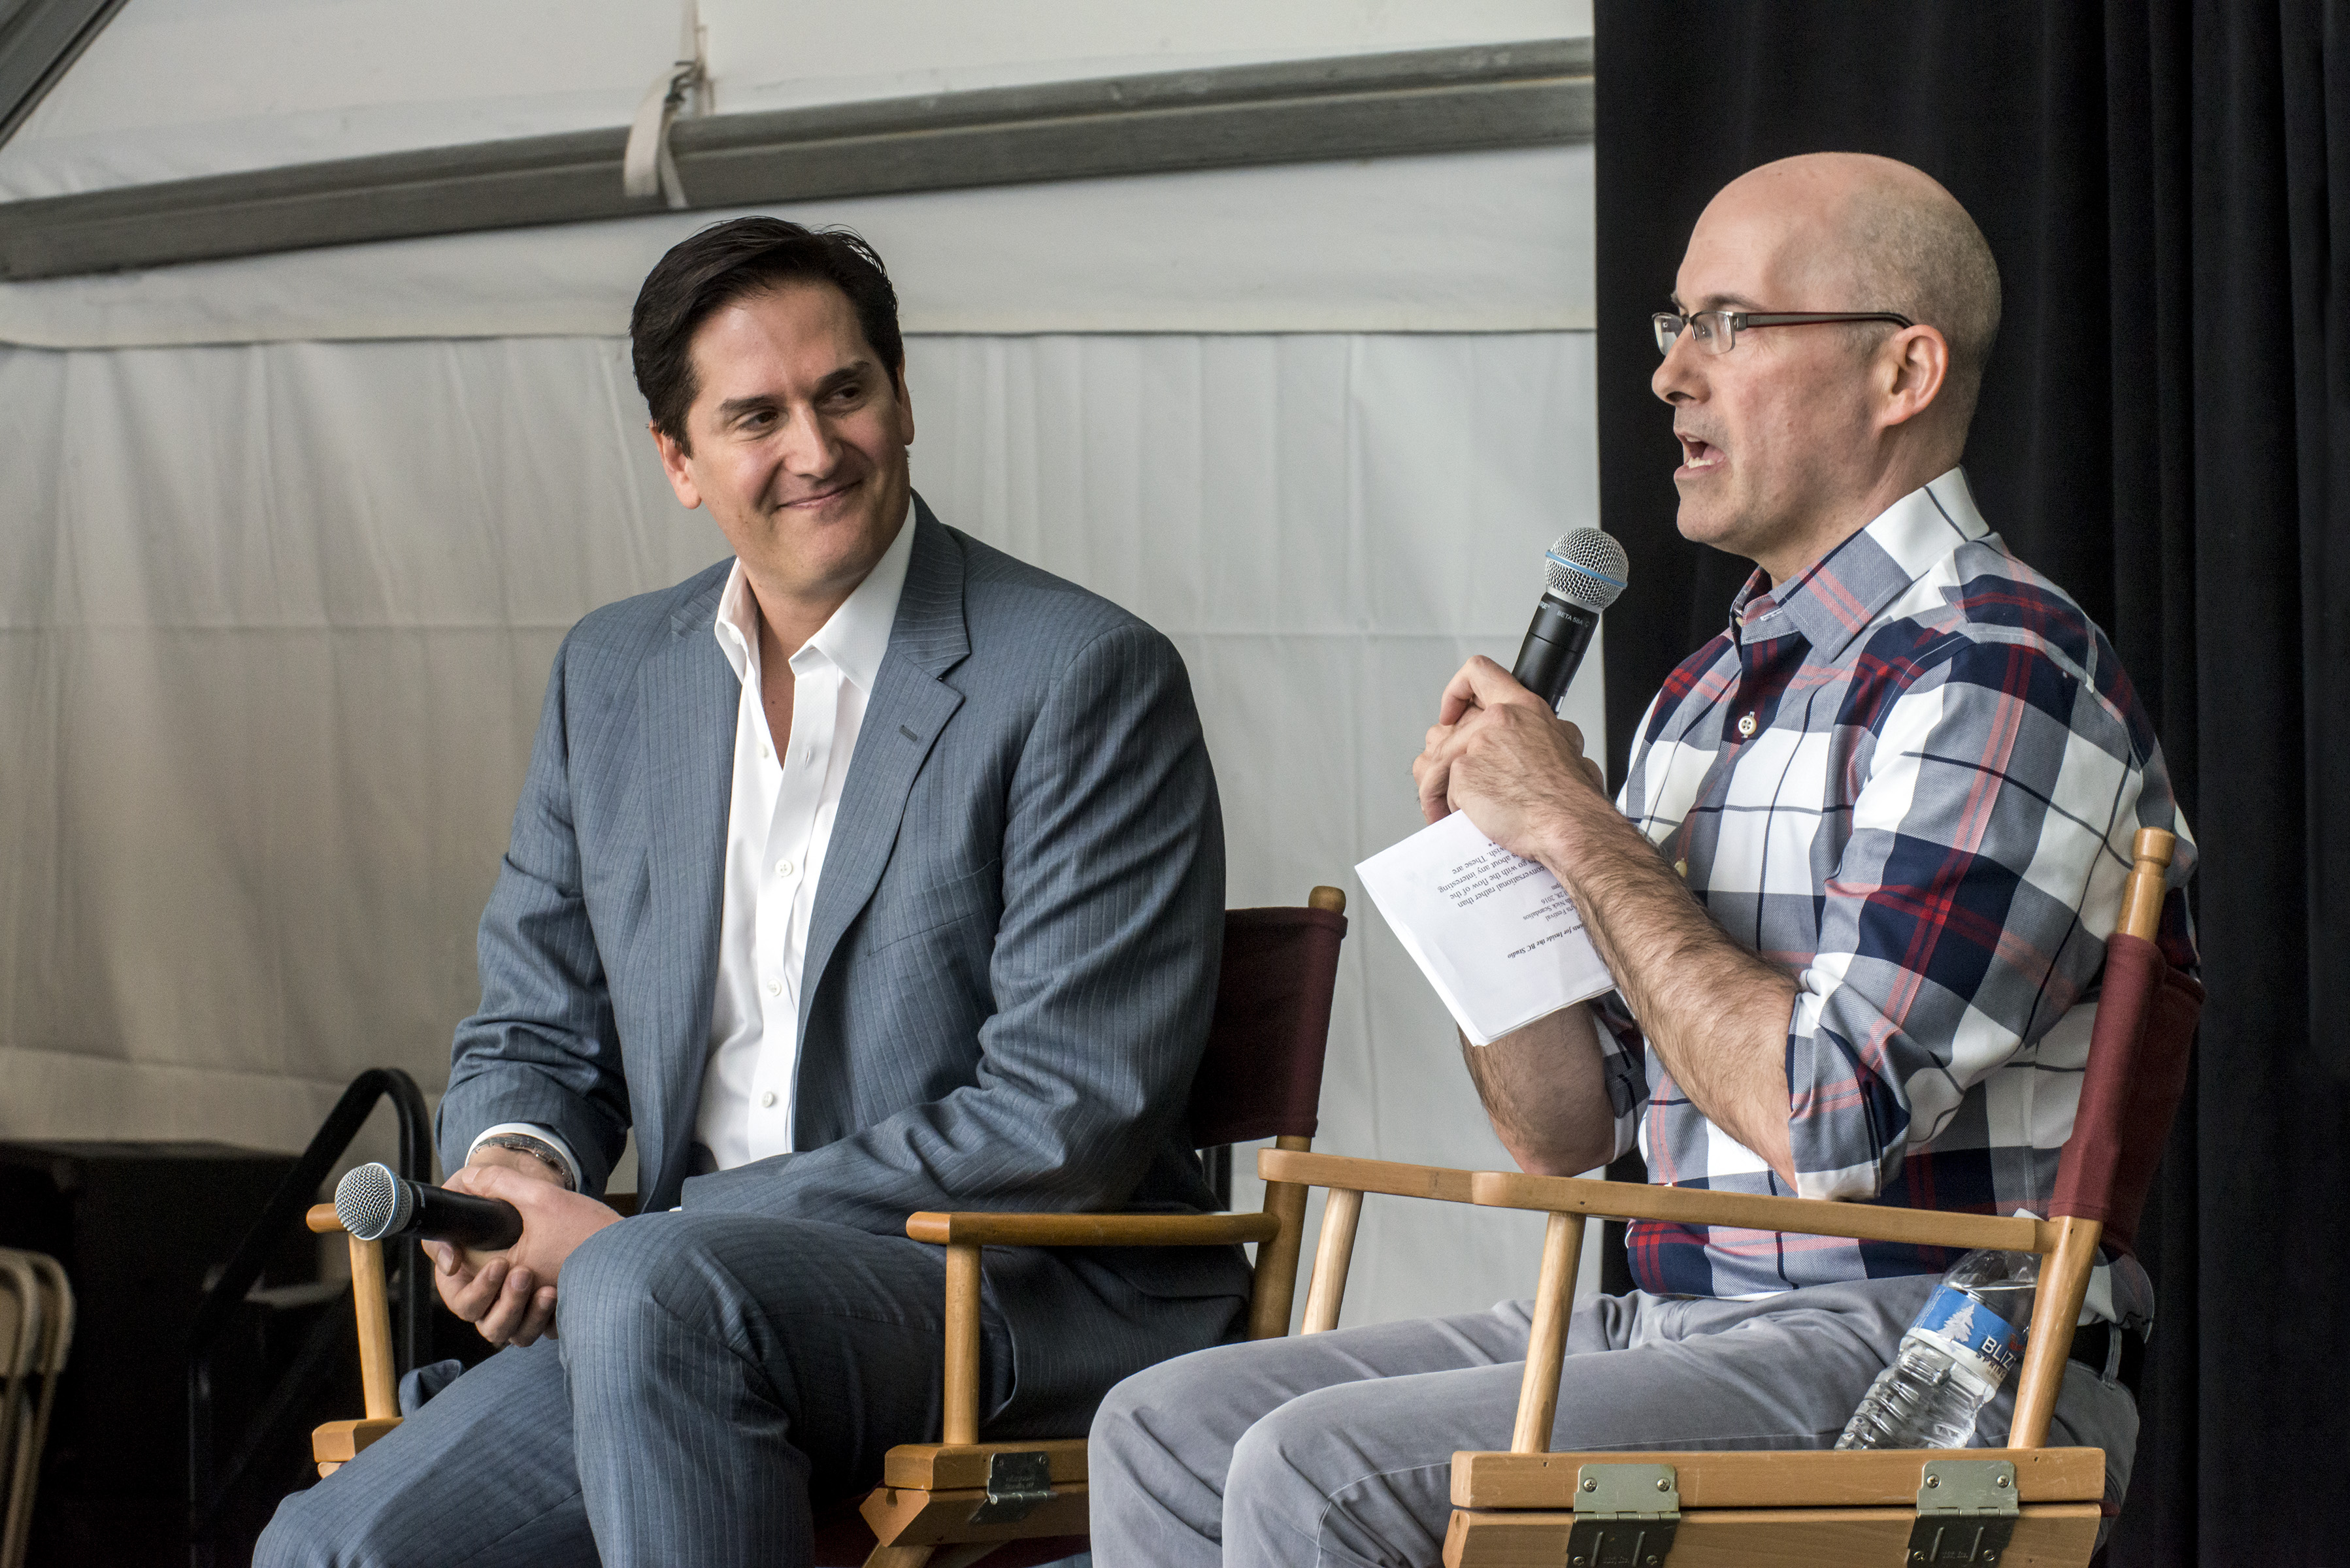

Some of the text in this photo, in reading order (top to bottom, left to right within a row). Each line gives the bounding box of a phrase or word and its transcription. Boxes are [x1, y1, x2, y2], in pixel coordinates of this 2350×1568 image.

[1557, 610, 1572, 621] BETA
[1465, 856, 1487, 868] These
[1491, 855, 1511, 868] about
[1517, 859, 1527, 868] go
[1452, 865, 1464, 874] are
[1478, 865, 1490, 874] any
[1500, 865, 1517, 876] with
[1437, 872, 1477, 892] interesting
[1457, 866, 1544, 908] conversational rather than
[1472, 878, 1489, 890] flow
[1463, 886, 1470, 896] of
[1541, 895, 1555, 904] 2016
[1552, 900, 1565, 909] Nick
[1523, 906, 1552, 920] Scandalios
[1546, 909, 1566, 921] Festival
[1546, 932, 1563, 942] Inside
[1507, 947, 1526, 958] Studio
